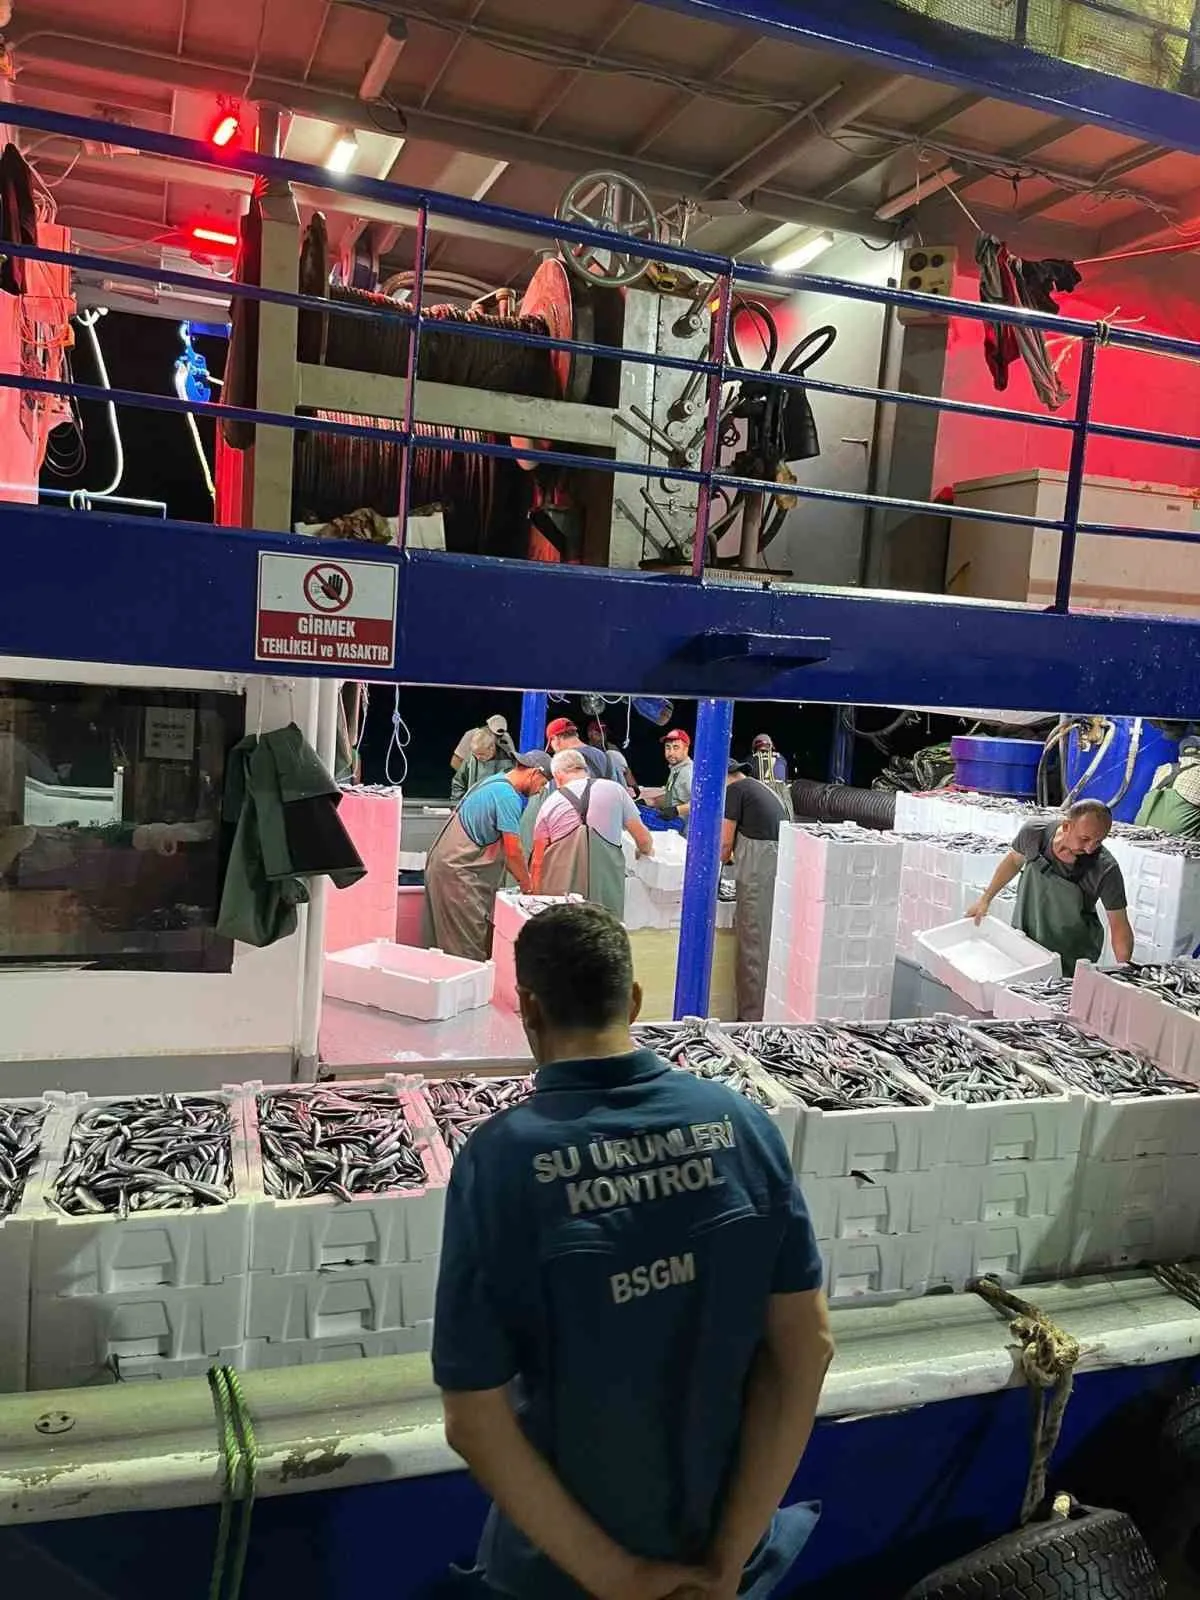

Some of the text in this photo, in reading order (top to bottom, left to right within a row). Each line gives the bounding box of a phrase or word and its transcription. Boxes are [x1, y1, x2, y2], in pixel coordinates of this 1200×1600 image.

[298, 615, 356, 637] GİRMEK
[262, 636, 389, 661] TEHLİKELİ ve YASAKTIR
[532, 1146, 582, 1184] SU
[566, 1158, 729, 1215] KONTROL
[609, 1252, 696, 1305] BSGM
